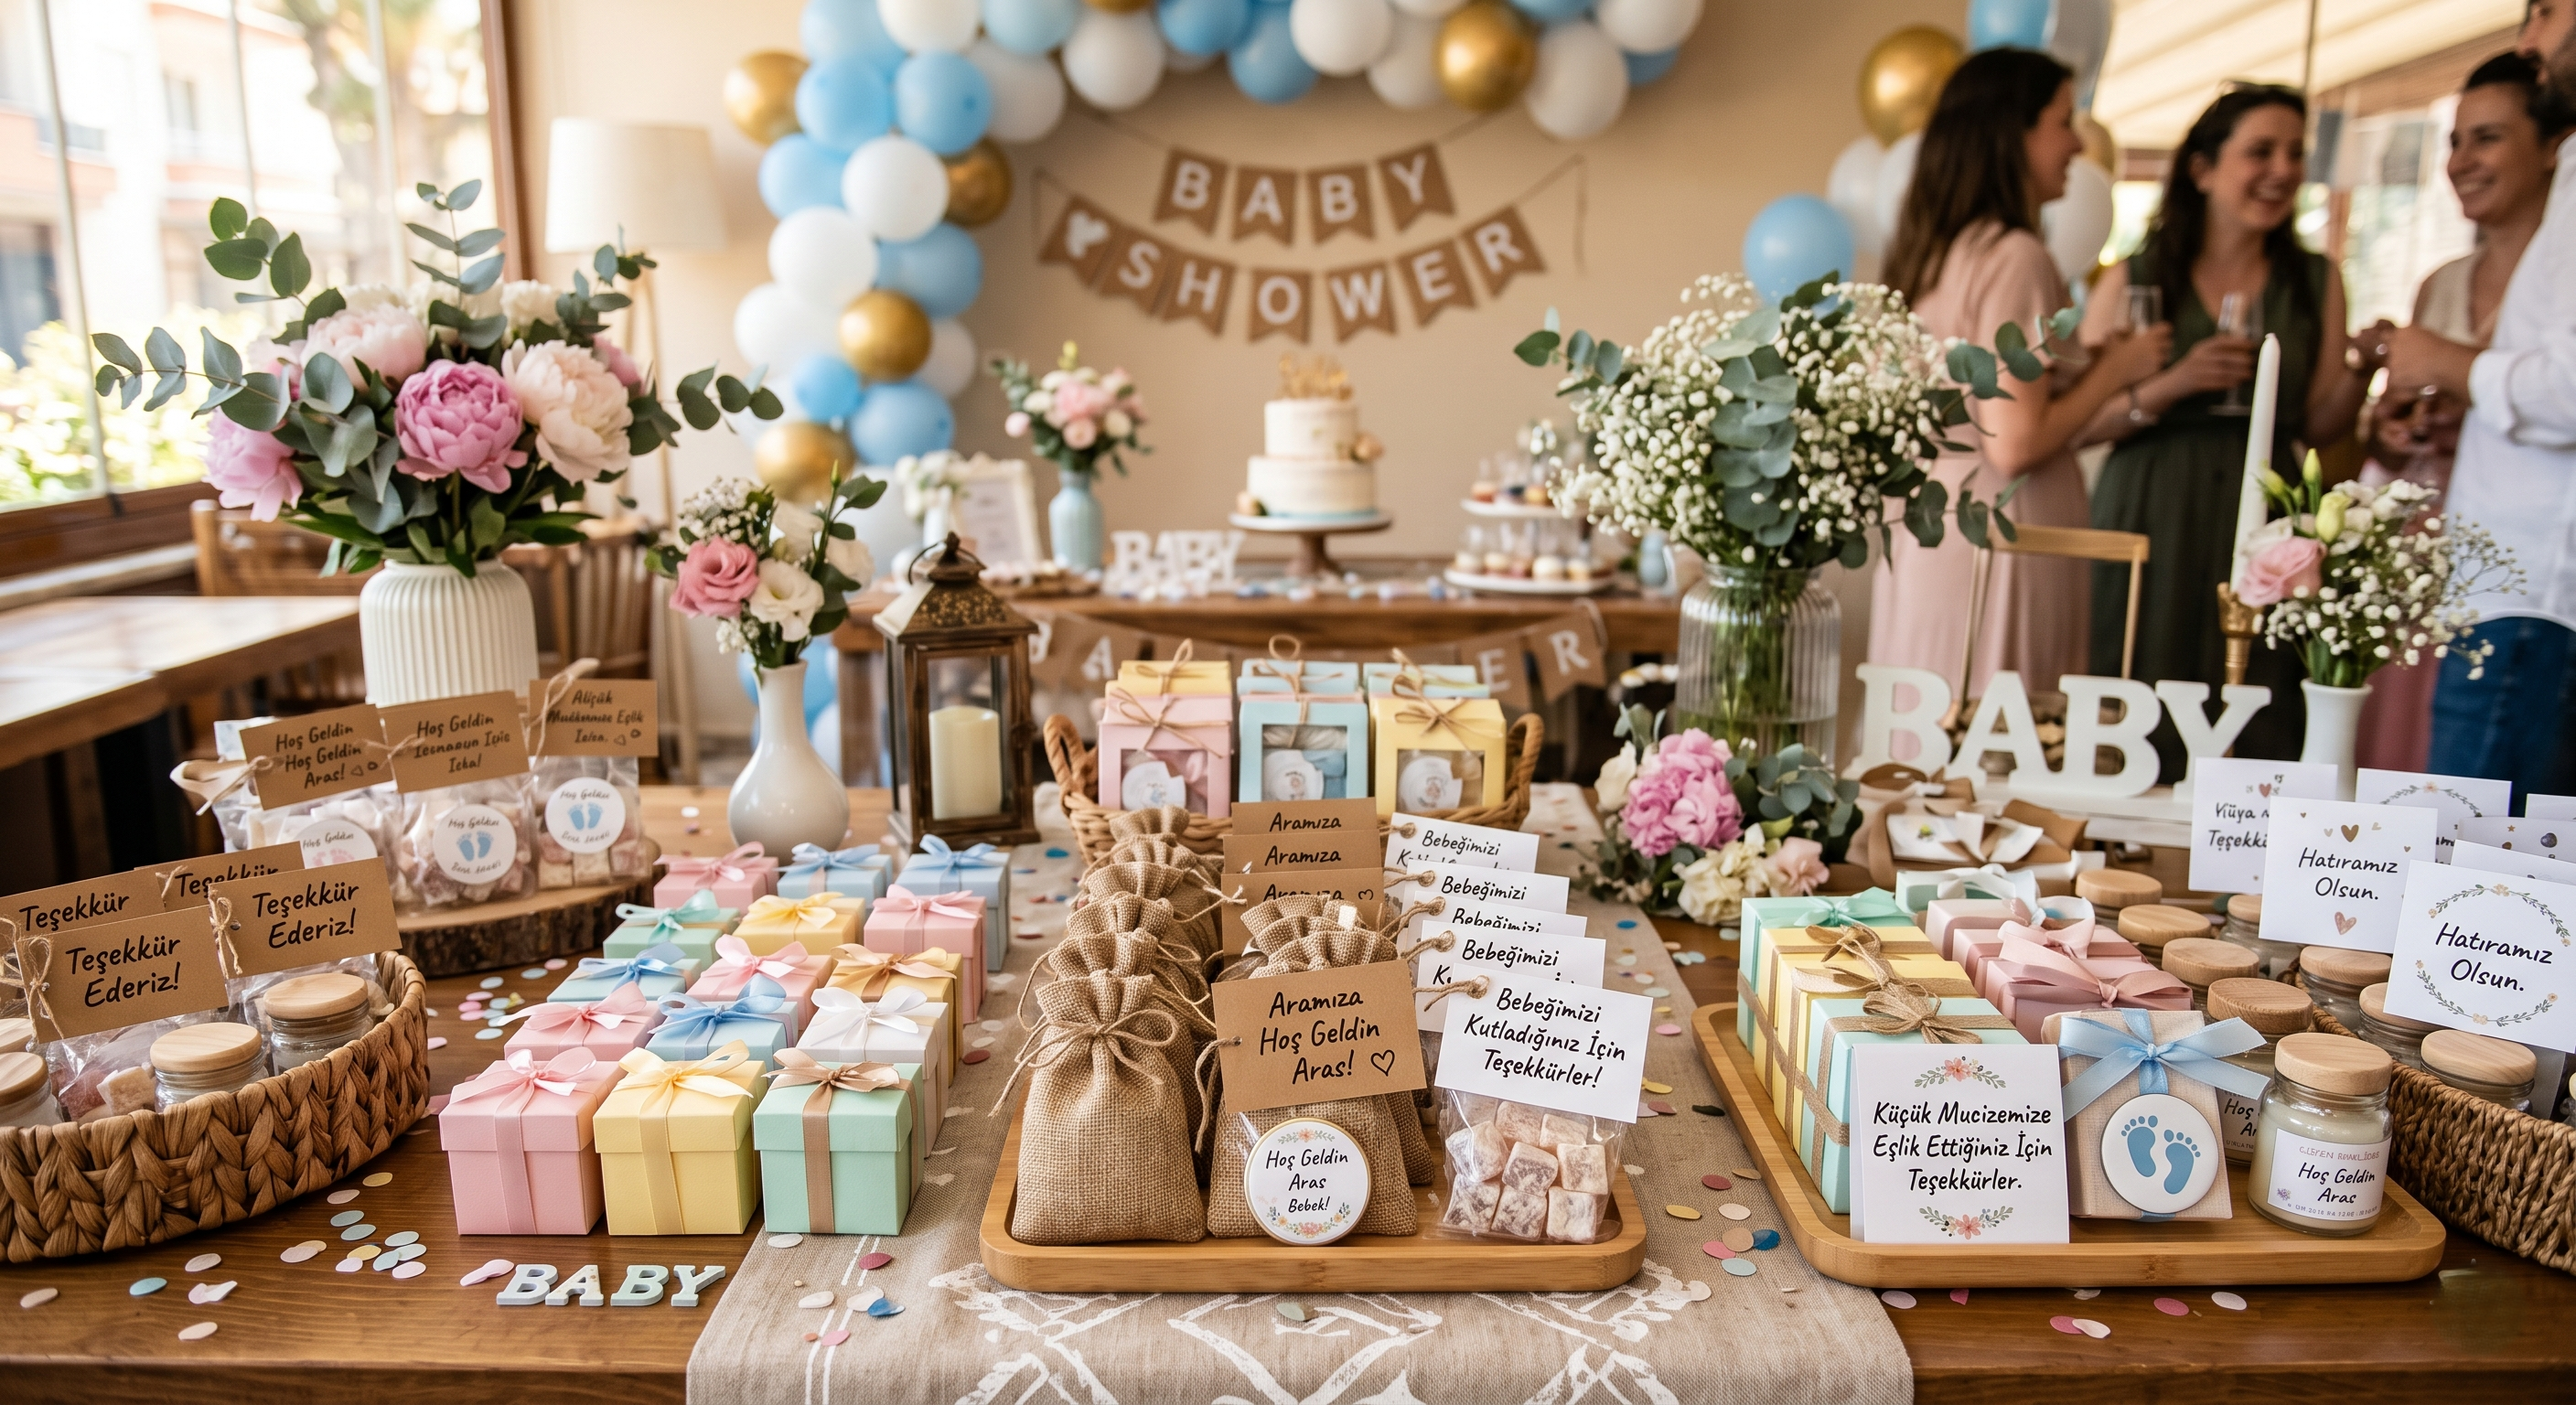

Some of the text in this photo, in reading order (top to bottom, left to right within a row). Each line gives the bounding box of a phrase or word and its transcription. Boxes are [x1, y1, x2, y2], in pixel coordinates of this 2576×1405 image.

[1169, 153, 1428, 223] BABY
[1119, 220, 1525, 325] SHOWER
[275, 722, 354, 753] Hoş Geldin
[416, 713, 494, 738] Hoş Geldin
[1841, 662, 2272, 802] BABY
[284, 743, 362, 772] Hoş Geldin
[304, 762, 346, 789] Aras!
[1269, 811, 1342, 832] Aramıza
[1263, 844, 1342, 866] Aramıza
[1421, 829, 1502, 856] Bebeğimizi
[2297, 846, 2399, 874] Hatıramız
[252, 881, 360, 918] Teşekkür
[1441, 875, 1529, 902] Bebeğimizi
[2314, 876, 2380, 901] Olsun.
[18, 891, 130, 932] Teşekkür
[267, 908, 357, 949] Ederiz!
[2434, 922, 2555, 965] Hatıramız
[65, 935, 181, 975] Teşekkür
[1461, 938, 1561, 969] Bebeğimizi
[84, 961, 181, 1008] Ederiz!
[2450, 958, 2526, 992] Olsun.
[1269, 990, 1364, 1020] Aramıza
[1496, 987, 1602, 1024] Bebeğimizi
[1259, 1016, 1380, 1056] Hoş Geldin
[1463, 1014, 1626, 1062] Kutladığınız İçin
[1292, 1050, 1354, 1085] Aras!
[1482, 1048, 1604, 1089] Teşekkürler!
[1873, 1101, 2052, 1130] Küçük Mucizemize
[2224, 1098, 2254, 1121] Hoş
[1265, 1147, 1349, 1171] Hoş Geldin
[1873, 1130, 2054, 1163] Eşlik Ettiğiniz İçin
[1288, 1173, 1327, 1192] Aras
[1907, 1168, 2023, 1193] Teşekkürler.
[2297, 1162, 2376, 1185] Hoş Geldin
[1287, 1196, 1330, 1213] Bebek!
[496, 1263, 726, 1307] BABY
